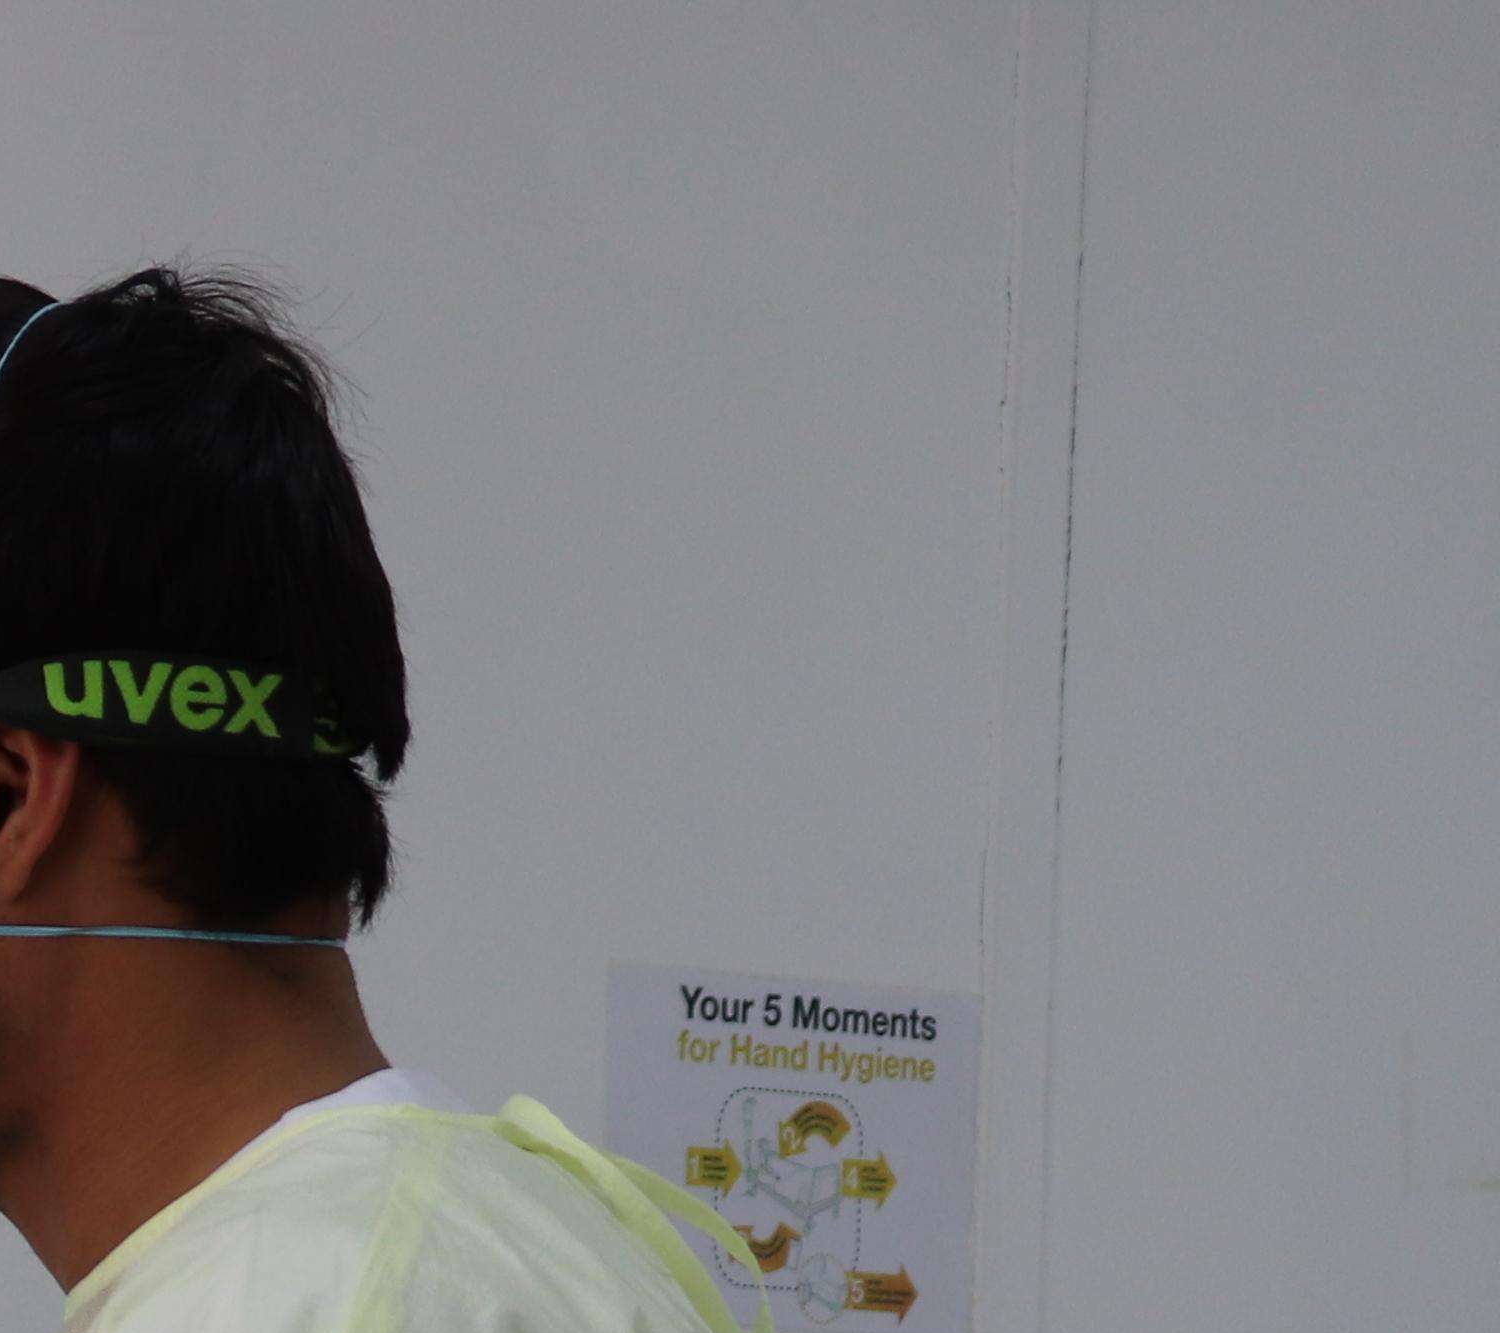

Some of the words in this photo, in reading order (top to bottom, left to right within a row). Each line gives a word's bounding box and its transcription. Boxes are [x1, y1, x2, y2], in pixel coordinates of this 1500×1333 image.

[42, 659, 284, 740] uvex
[680, 984, 755, 1024] Your
[763, 993, 783, 1027] 5
[791, 994, 938, 1042] Moments
[677, 1028, 722, 1064] for
[729, 1031, 810, 1073] Hand
[817, 1039, 937, 1085] Hygiene
[850, 1278, 865, 1303] 5
